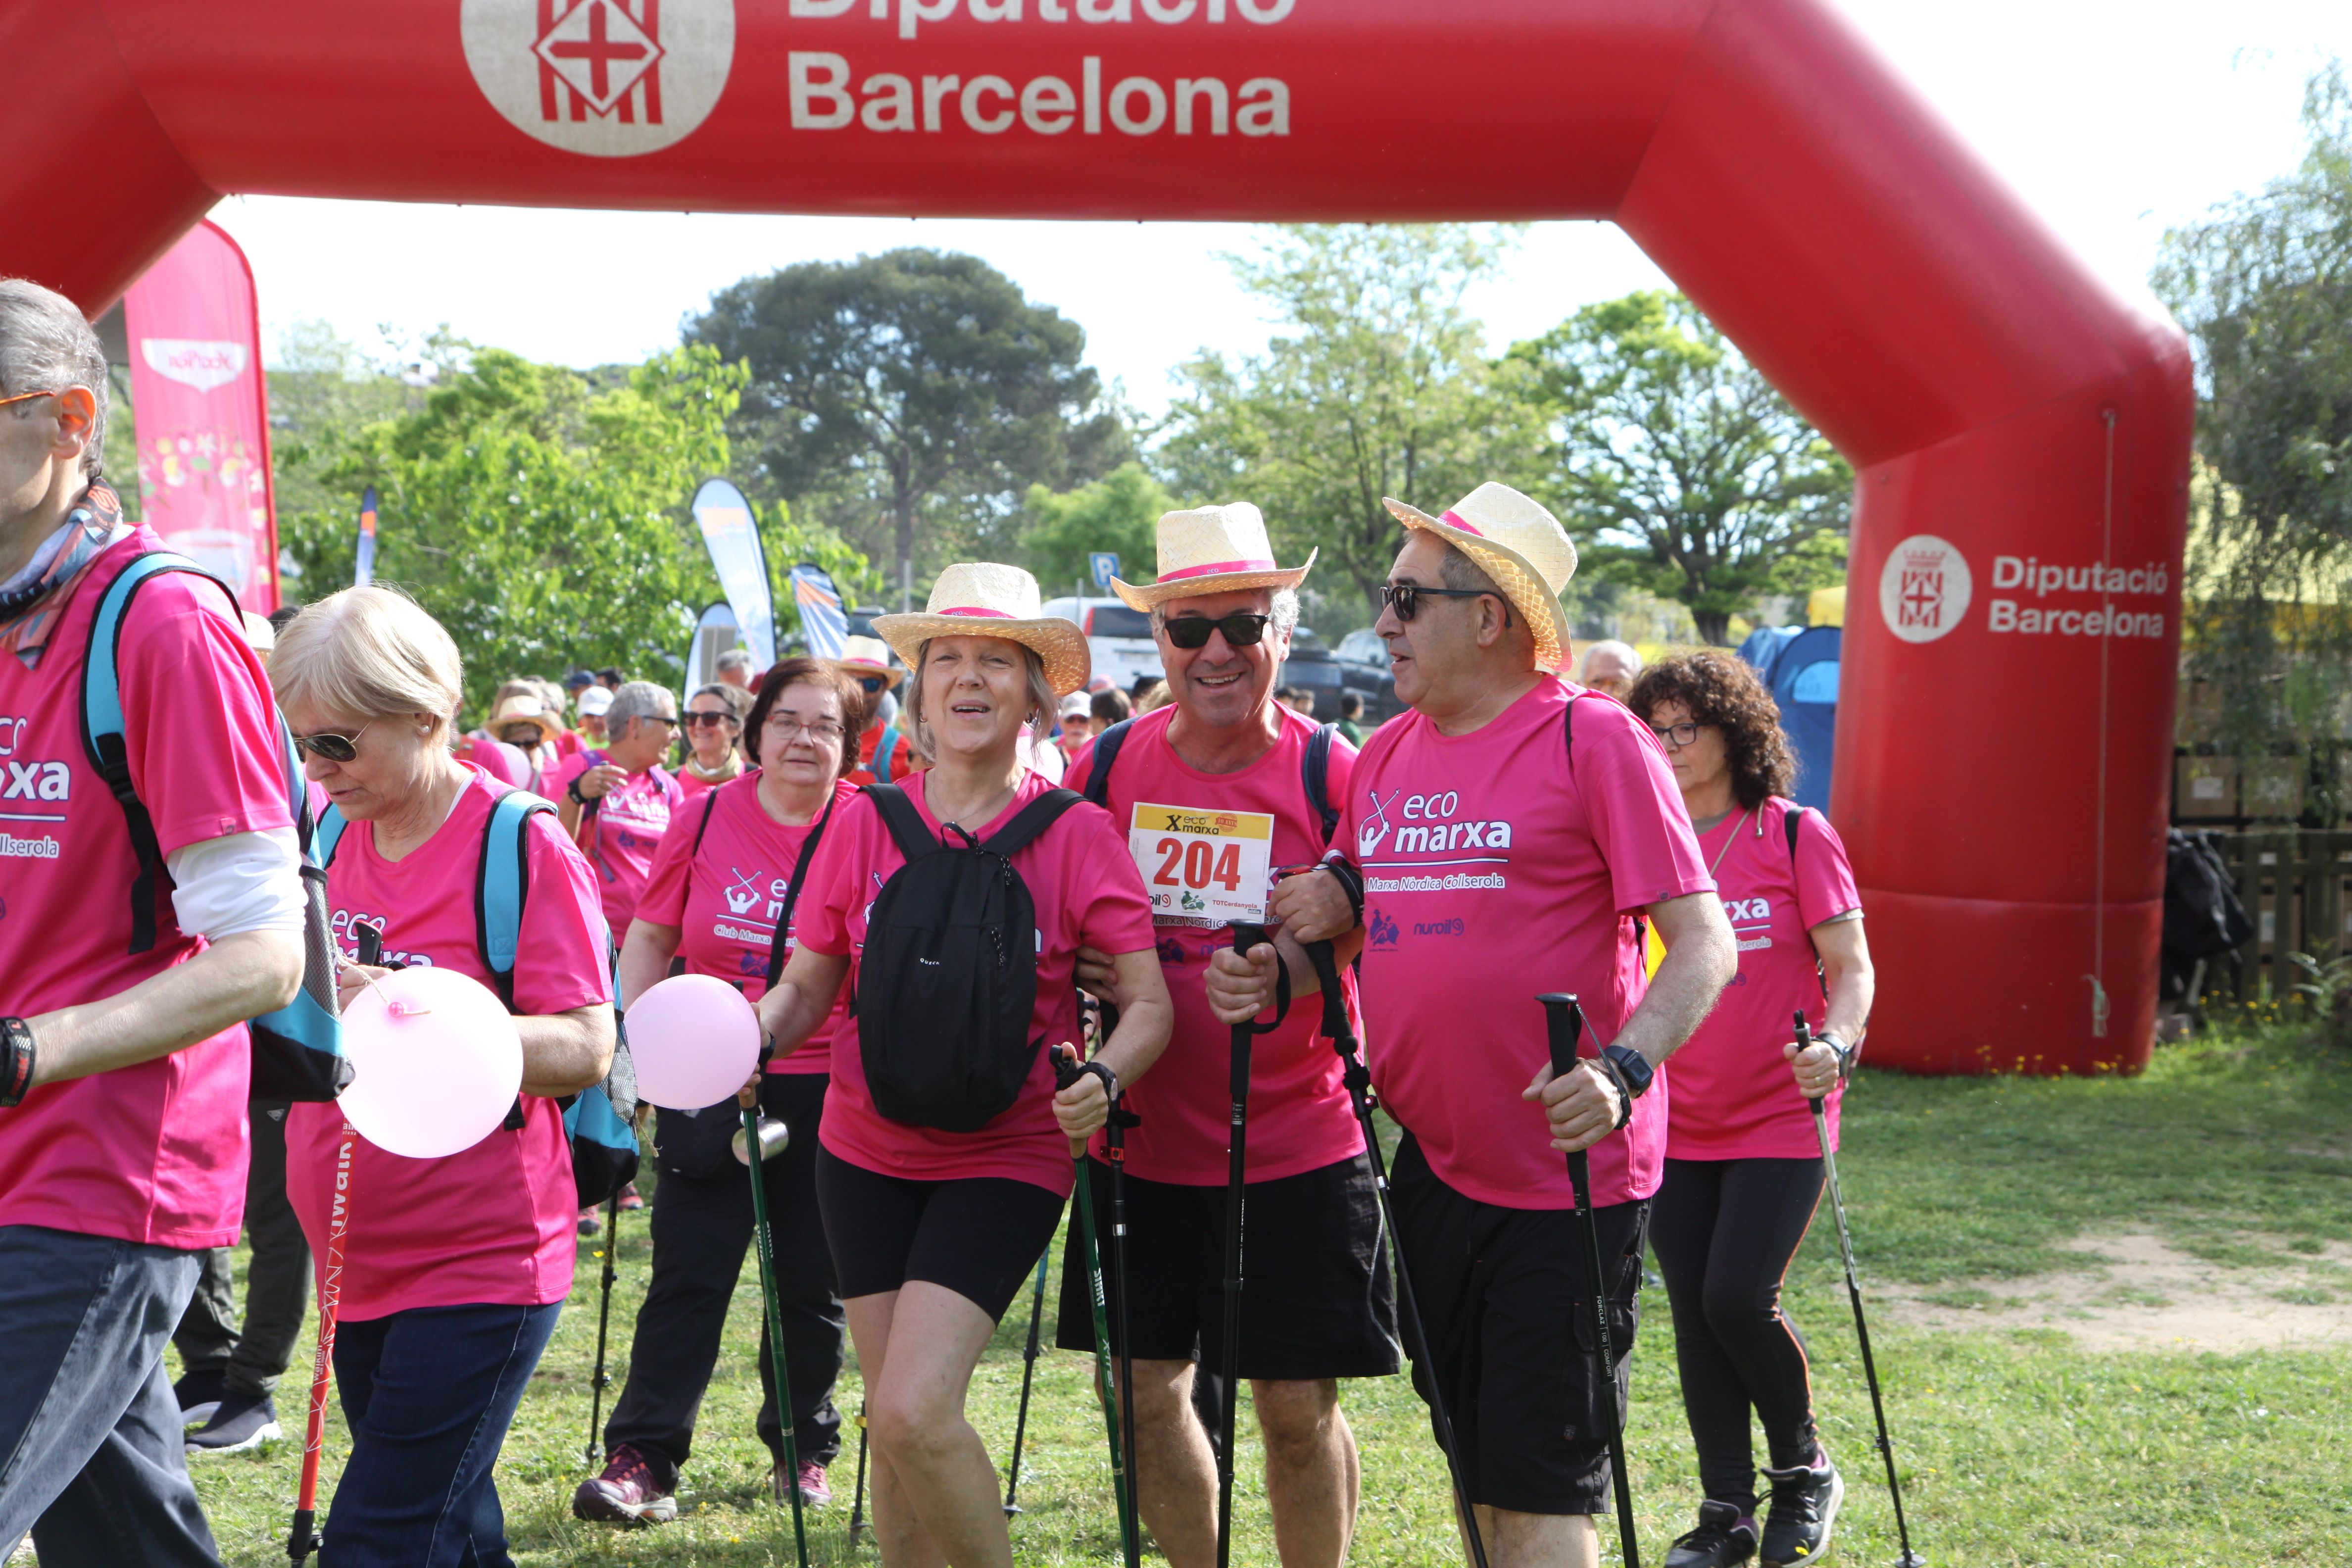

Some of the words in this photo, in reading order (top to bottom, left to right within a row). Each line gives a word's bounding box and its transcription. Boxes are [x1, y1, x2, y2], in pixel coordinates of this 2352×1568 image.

[788, 50, 1290, 137] Barcelona
[1096, 557, 1115, 583] P
[1992, 555, 2168, 597] Diputació
[1988, 599, 2164, 638] Barcelona
[1402, 790, 1459, 819] eco
[1182, 824, 1220, 835] marxa
[1183, 816, 1206, 826] eco
[1394, 820, 1512, 852] marxa
[1153, 837, 1241, 891] 204
[1368, 878, 1399, 892] Marxa
[1399, 875, 1441, 891] Nòrdica
[1443, 872, 1506, 889] Collserola
[1212, 899, 1258, 909] TOTCerdanyola
[714, 925, 737, 938] Club
[738, 929, 771, 945] Marxa
[1414, 919, 1452, 935] nuroil
[1596, 1295, 1606, 1325] FORCLAZ
[1603, 1348, 1613, 1378] COMFORT
